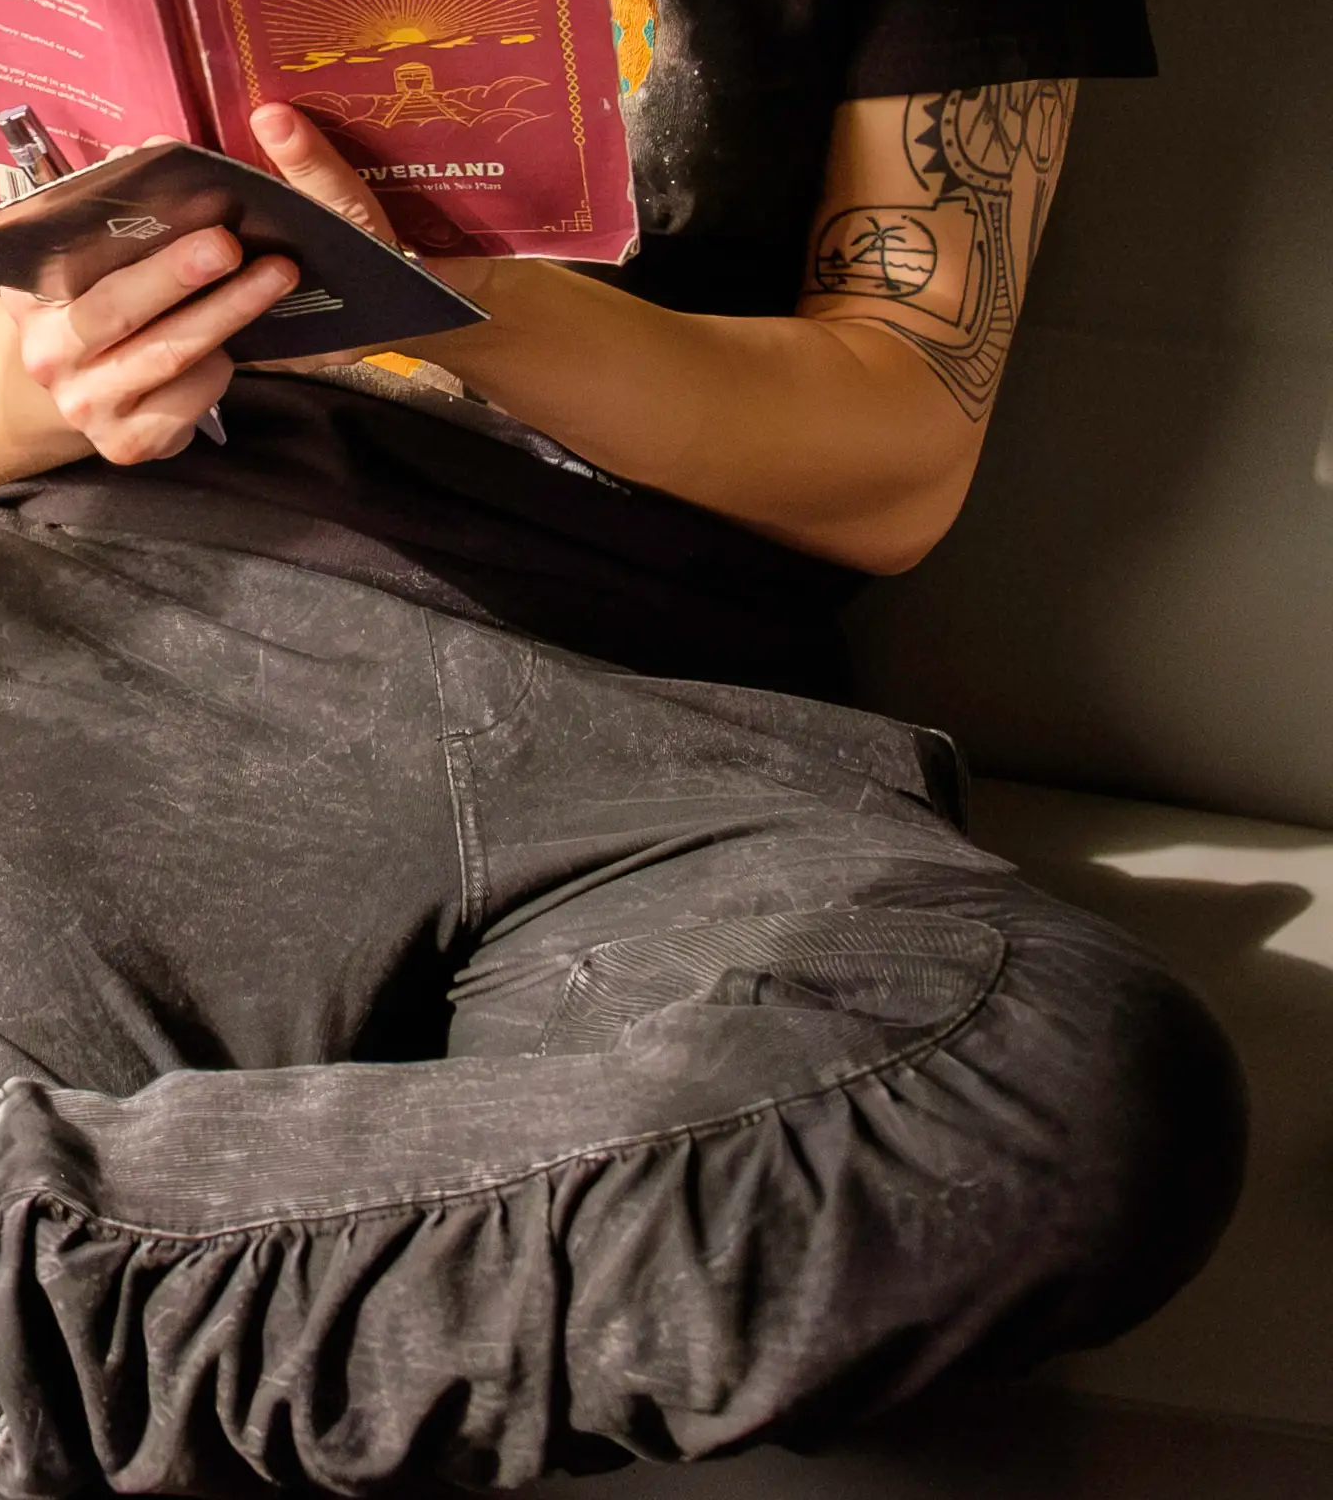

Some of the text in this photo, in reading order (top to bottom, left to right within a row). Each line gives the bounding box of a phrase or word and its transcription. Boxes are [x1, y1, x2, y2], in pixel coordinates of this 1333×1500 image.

[423, 181, 450, 192] with
[452, 181, 471, 191] No
[474, 180, 502, 191] Plan
